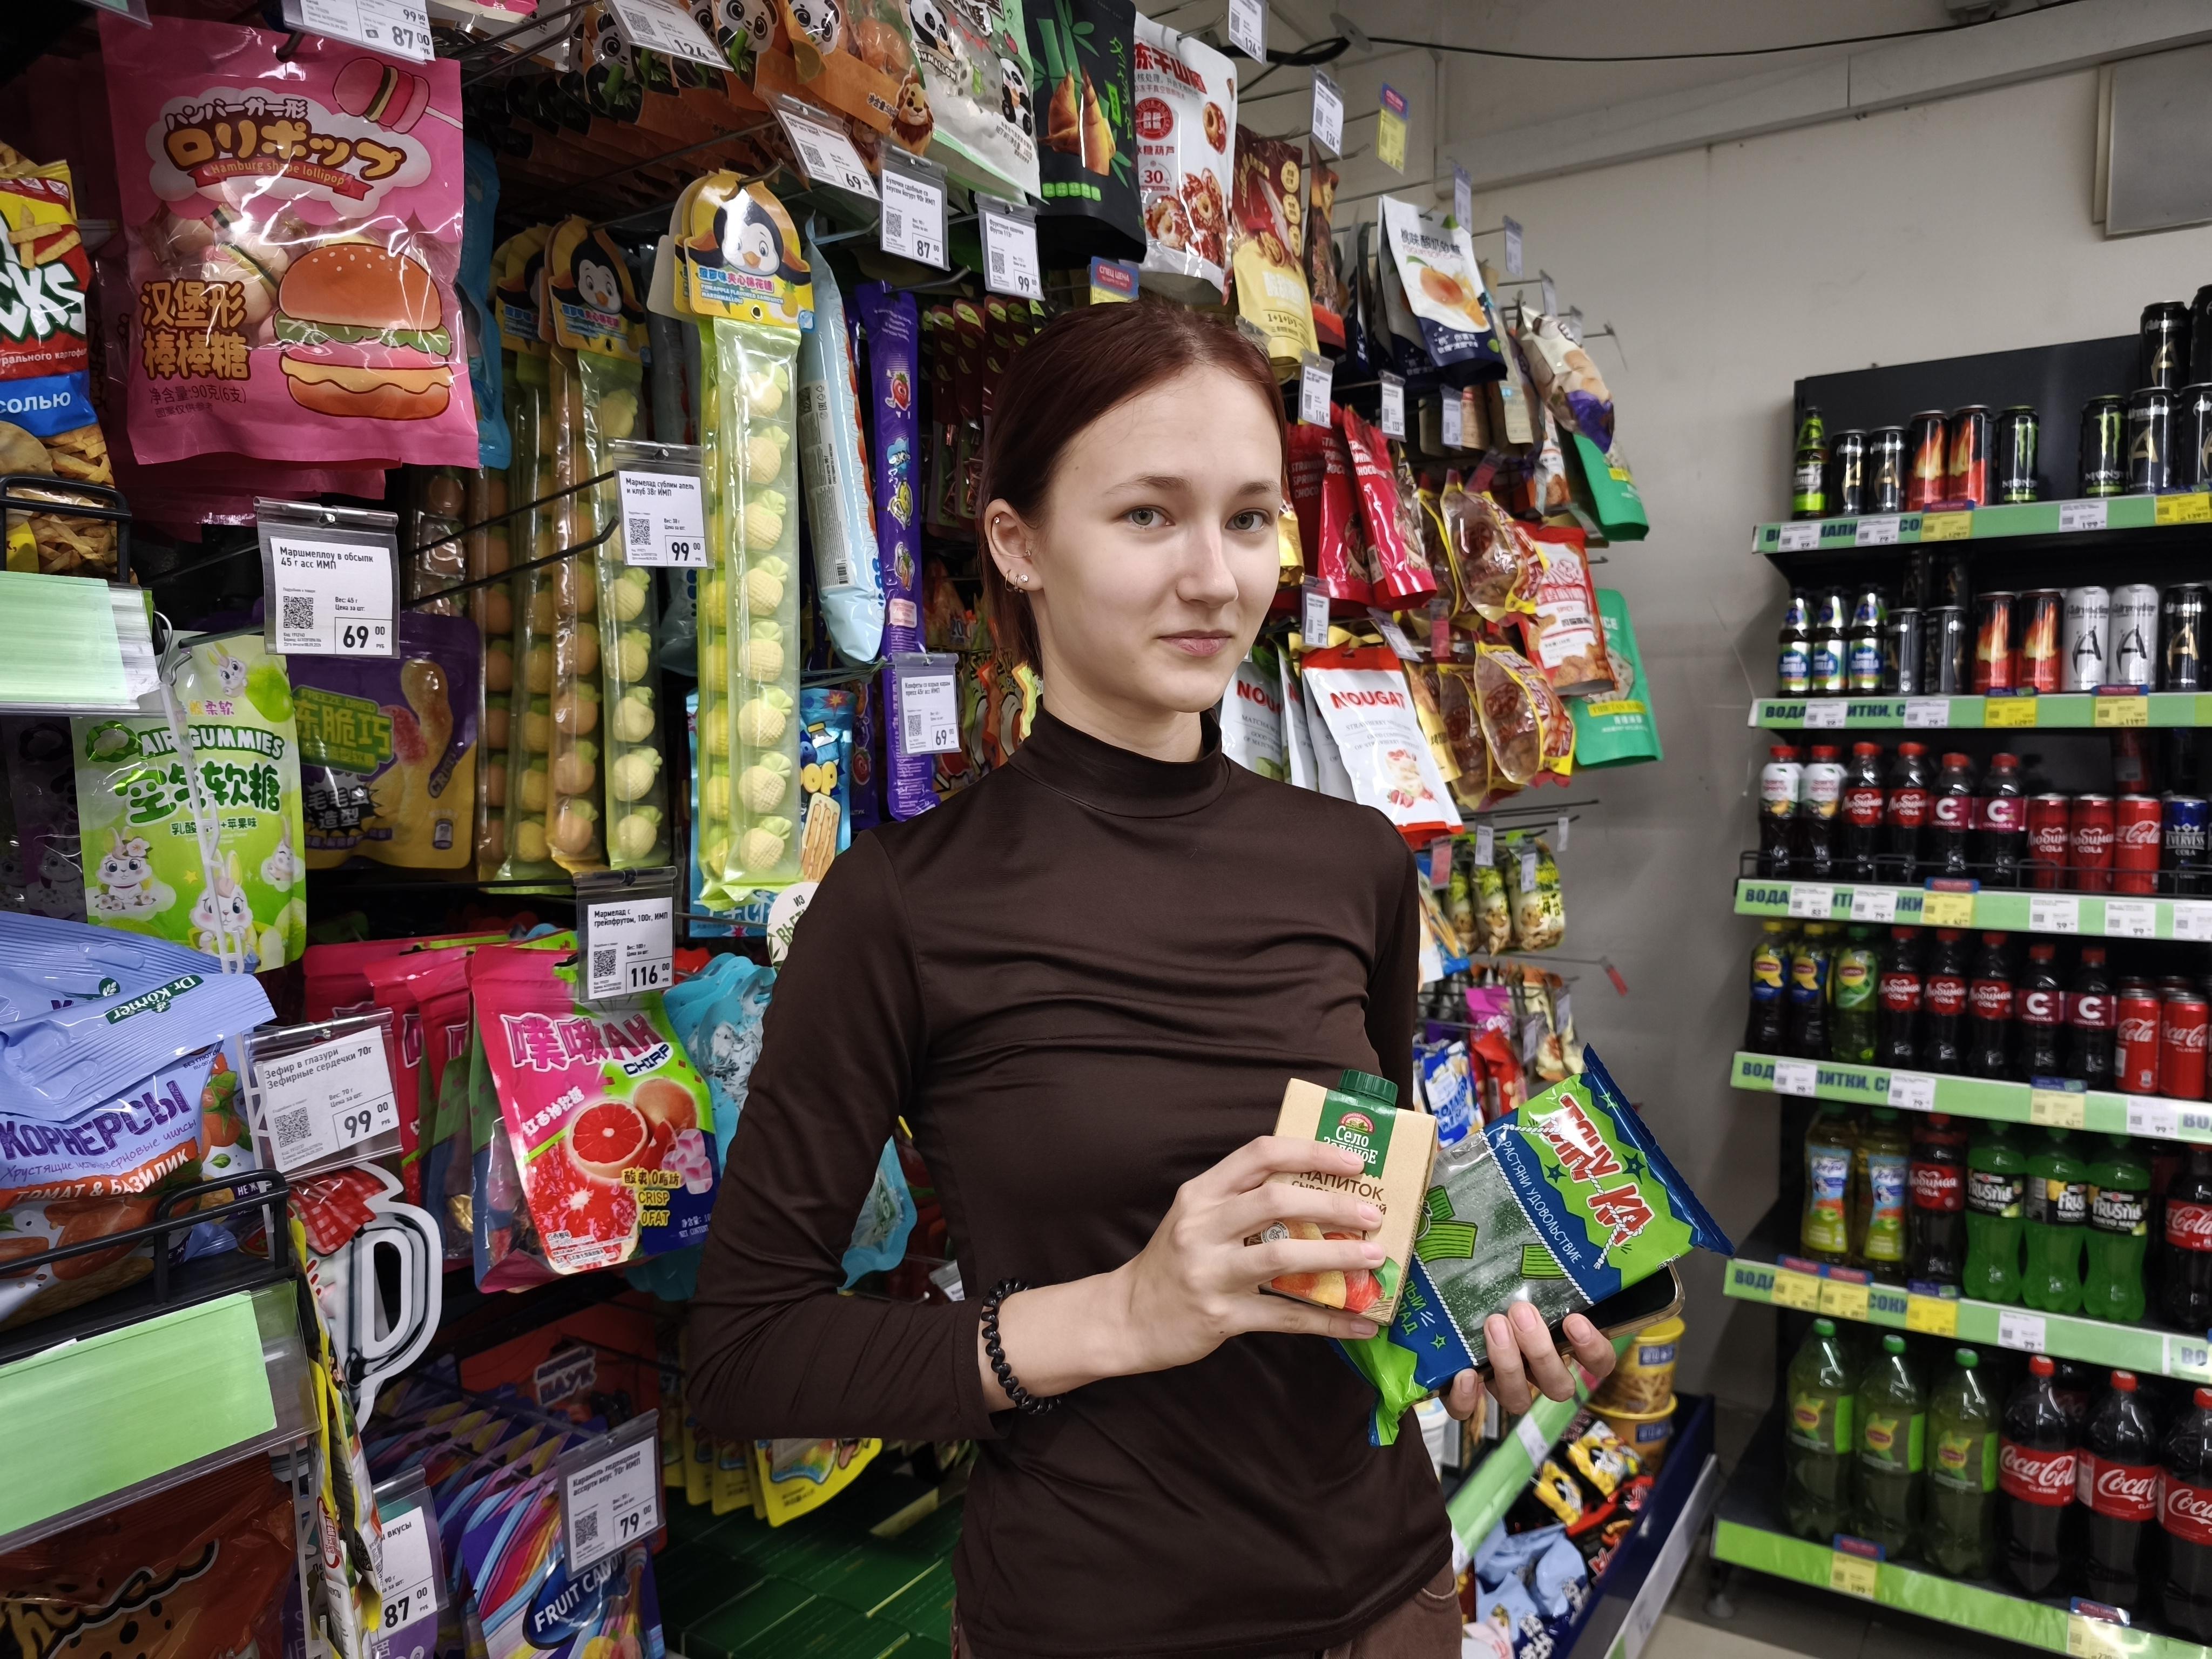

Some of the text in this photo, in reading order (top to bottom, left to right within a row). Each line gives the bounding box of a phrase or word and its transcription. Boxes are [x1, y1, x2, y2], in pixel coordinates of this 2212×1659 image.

[403, 9, 416, 22] 99
[392, 26, 430, 49] 87 00
[674, 39, 709, 60] 124
[164, 97, 308, 131] ハンバーガー形
[165, 118, 403, 178] ロリポップ
[212, 161, 345, 186] Hamburg shape lollipop
[846, 173, 861, 190] 69
[886, 176, 922, 194] Булочки сдобные
[886, 185, 935, 206] вкусом йогурт ИМП
[917, 240, 930, 259] 87
[1019, 276, 1029, 292] 99
[140, 280, 245, 328] 汉堡形
[143, 330, 249, 379] 棒棒糖
[626, 478, 656, 488] Мармелад
[280, 546, 335, 562] Маршмеллоу
[345, 552, 374, 563] обсыпк
[281, 557, 292, 566] 45
[316, 561, 336, 570] ИМП
[671, 542, 689, 561] 99
[343, 625, 385, 649] 69 00
[1330, 691, 1405, 710] NOUGAT
[190, 728, 283, 757] GUMMIES
[935, 730, 947, 745] 69
[793, 895, 805, 907] ИЗ
[594, 909, 626, 919] Мармелад
[594, 912, 668, 928] грейпфрутом, 100г, ИМП
[631, 965, 658, 987] 116
[662, 963, 670, 971] 00
[114, 976, 196, 1019] Dr. Körner
[265, 1064, 295, 1079] Зефир
[305, 1048, 339, 1066] глазури
[267, 1046, 372, 1089] Зефирные сердечки 70г
[624, 1044, 670, 1075] CHIRP
[0, 1080, 192, 1160] КОРНЕРСЫ
[344, 1102, 389, 1139] 99 00
[1336, 1125, 1369, 1147] Село
[1, 1162, 74, 1182] Хрустящие
[164, 1118, 197, 1141] чипсы
[16, 1148, 189, 1202] ТОМАТ & БАЗИЛИК
[1300, 1171, 1384, 1201] НАПИТОК
[639, 1191, 669, 1204] CRISP
[1501, 1139, 1582, 1264] РАСТЯНИ УДОВОЛЬСТВИЕ
[1404, 1280, 1427, 1311] ЛЫЙ
[1399, 1300, 1418, 1336] ЛАД
[573, 1469, 603, 1487] Карамель
[574, 1458, 640, 1496] ассорти вкус ИМП
[387, 1521, 412, 1538] вкусы
[620, 1505, 652, 1539] 79 00
[384, 1587, 428, 1629] 87 00
[534, 1583, 580, 1633] FRUIT
